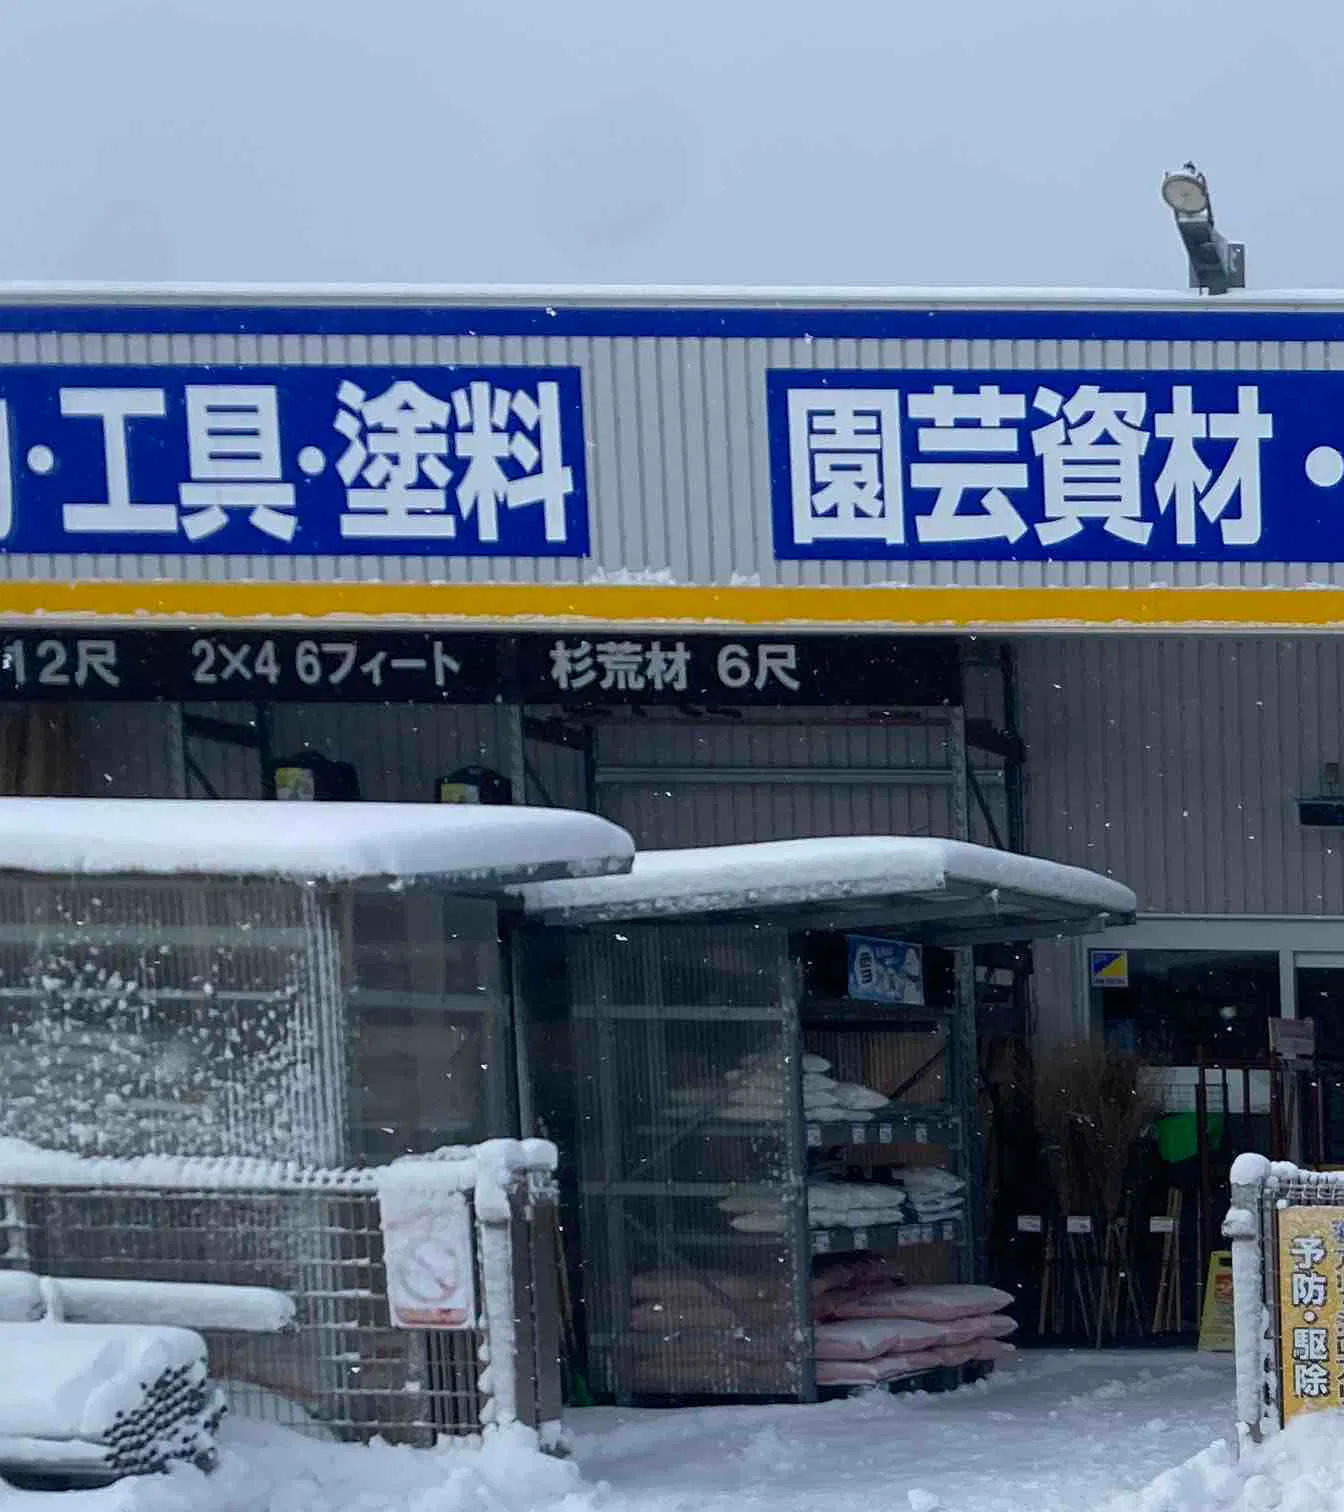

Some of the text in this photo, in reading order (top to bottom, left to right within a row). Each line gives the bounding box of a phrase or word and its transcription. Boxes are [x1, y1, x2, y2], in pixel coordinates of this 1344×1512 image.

[0, 379, 575, 543] ・工具・塗料
[550, 645, 800, 691] 杉荒材 6尺
[1291, 1235, 1329, 1397] 予防・駆除
